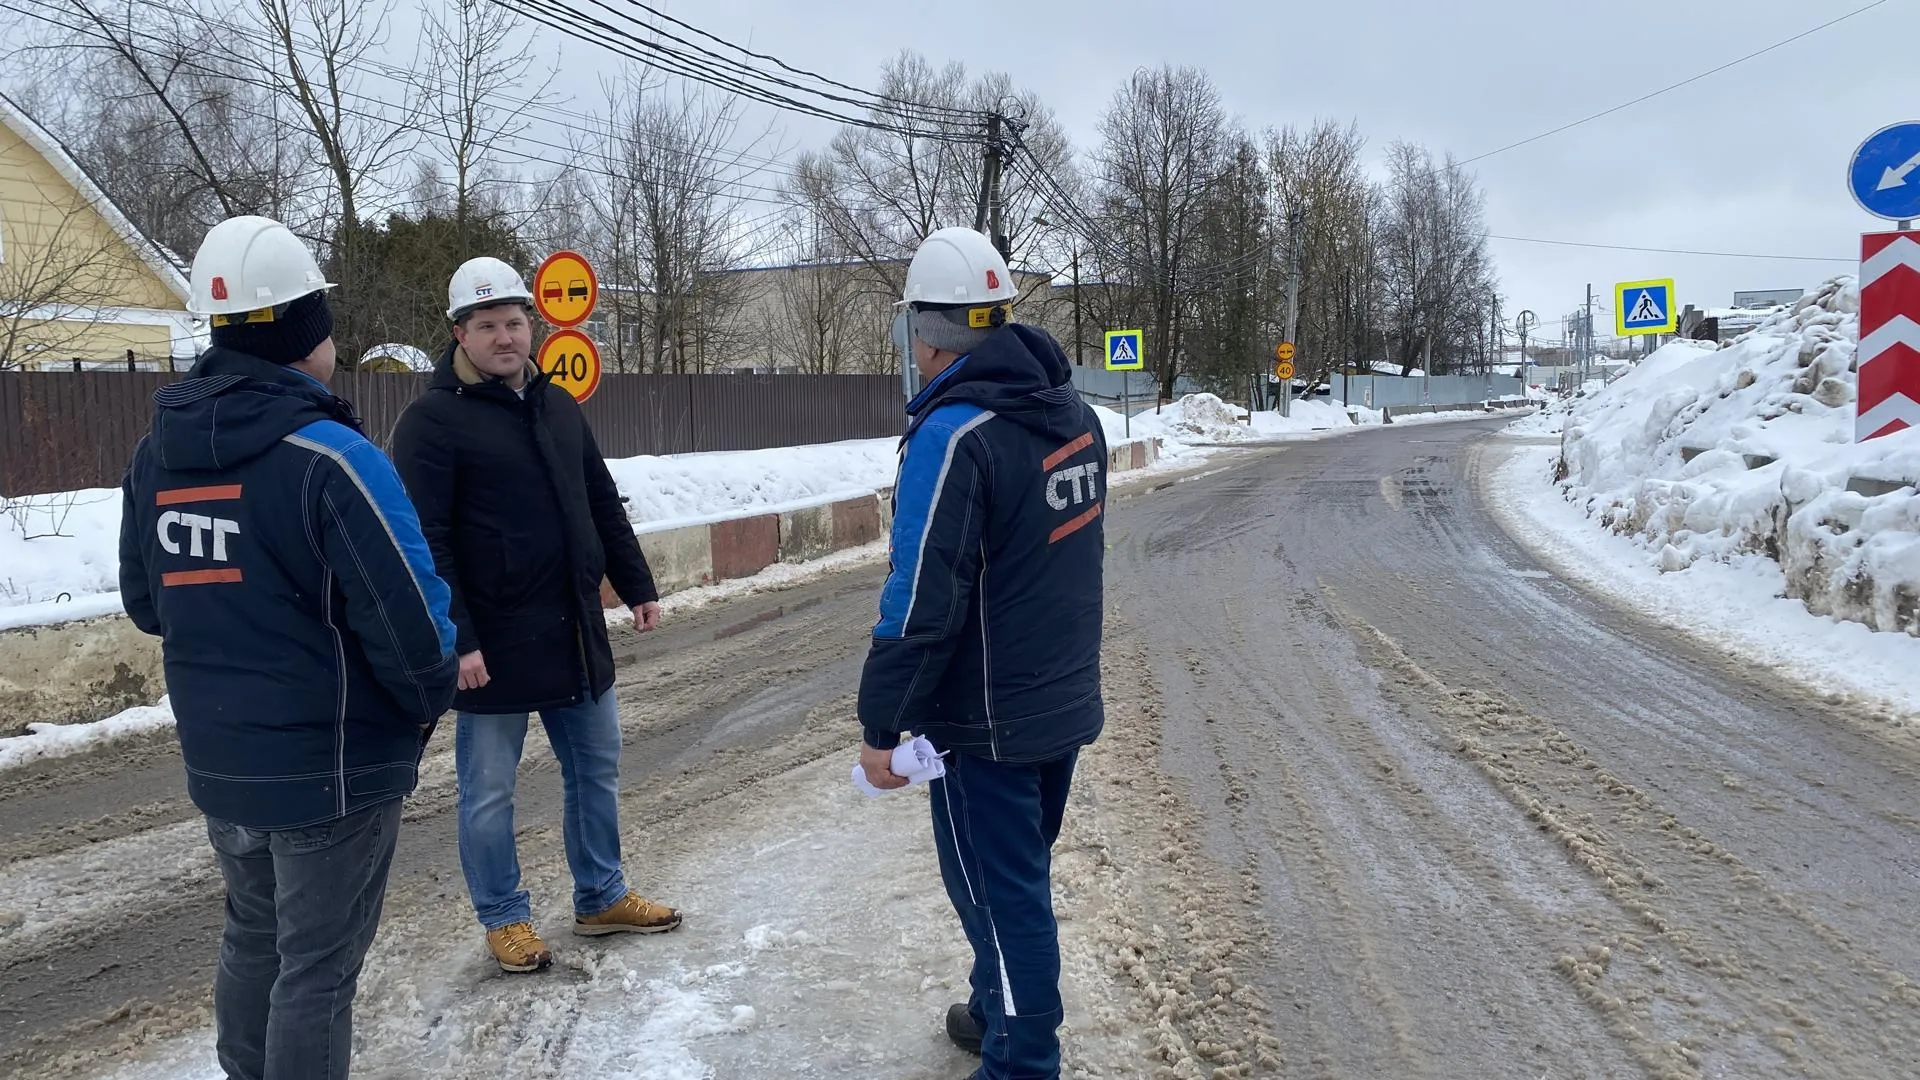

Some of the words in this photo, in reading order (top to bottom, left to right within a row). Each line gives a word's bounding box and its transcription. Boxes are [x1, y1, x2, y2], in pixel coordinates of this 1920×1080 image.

[476, 288, 492, 296] СТГ
[549, 353, 587, 382] 40
[1280, 367, 1291, 375] 40
[1046, 462, 1099, 510] СТГ
[157, 511, 240, 561] СТГ
